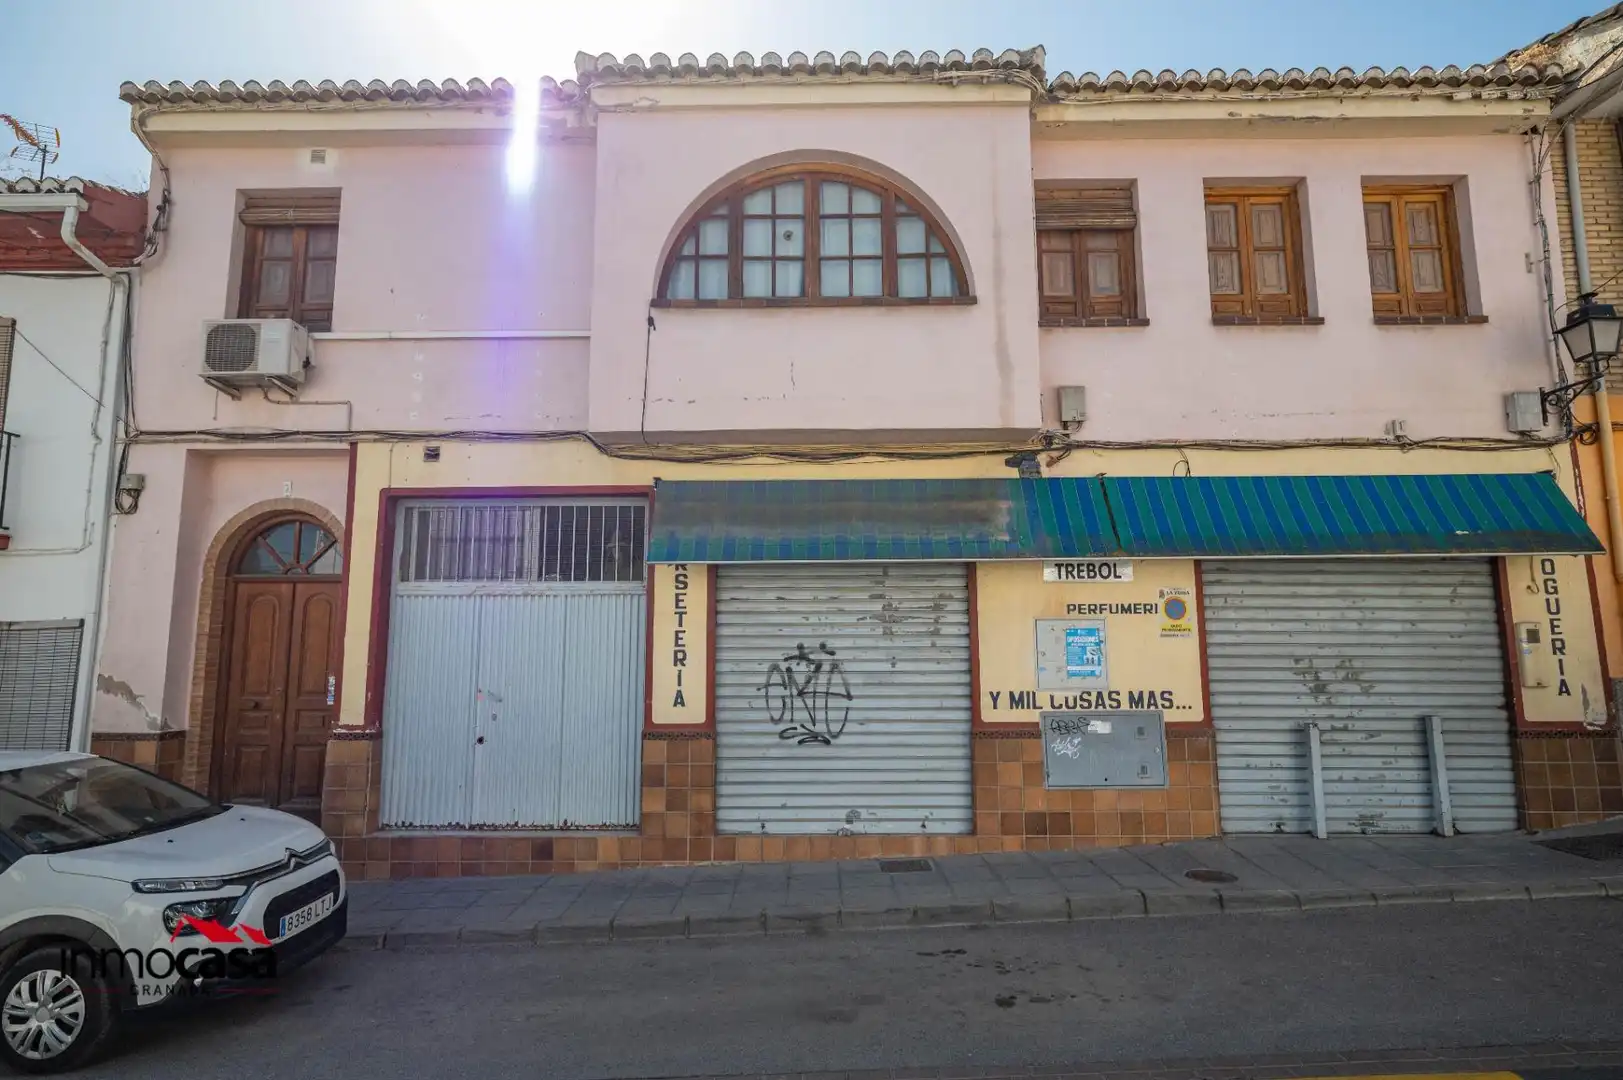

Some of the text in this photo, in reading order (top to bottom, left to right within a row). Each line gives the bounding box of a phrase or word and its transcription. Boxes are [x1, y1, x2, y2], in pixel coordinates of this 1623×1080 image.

[1054, 562, 1122, 580] TREBOL
[1066, 602, 1159, 615] PERFUMERI
[1541, 558, 1571, 697] OGUERIA
[988, 690, 1001, 710] Y
[1009, 690, 1043, 710] MIL
[287, 895, 332, 931] 8358 LTJ
